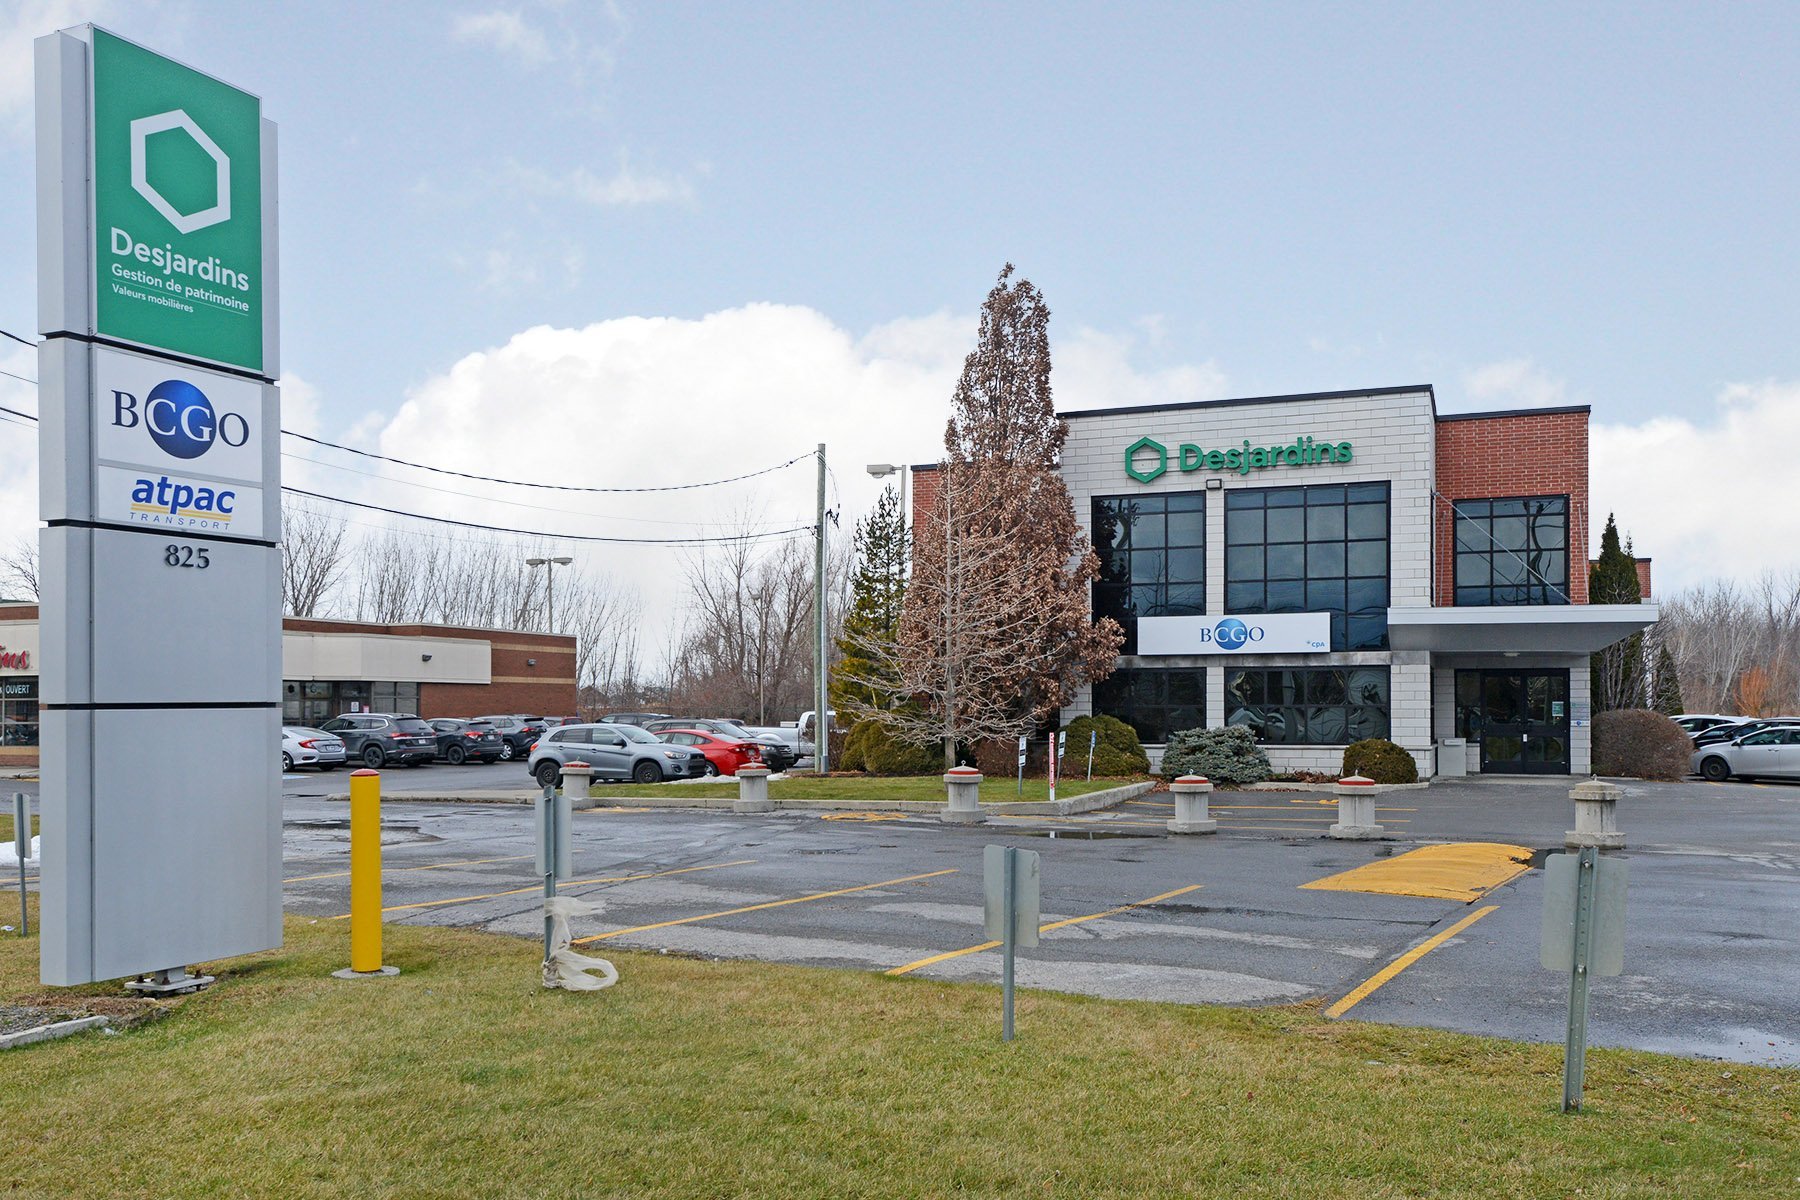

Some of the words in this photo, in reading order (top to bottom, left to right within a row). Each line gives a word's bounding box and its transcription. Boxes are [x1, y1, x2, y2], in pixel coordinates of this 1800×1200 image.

[111, 226, 249, 292] Desjardins
[111, 263, 163, 288] Gestion
[165, 278, 183, 293] de
[185, 286, 249, 312] patrimoine
[111, 283, 147, 301] Valeurs
[147, 294, 194, 313] mobilières
[111, 389, 250, 447] BCGO
[1179, 435, 1353, 476] Desjardins
[131, 476, 236, 515] atpac
[129, 511, 231, 531] TRANSPORT
[164, 544, 211, 569] 825
[1200, 626, 1265, 643] BCGO
[5, 684, 30, 694] OUVERT
